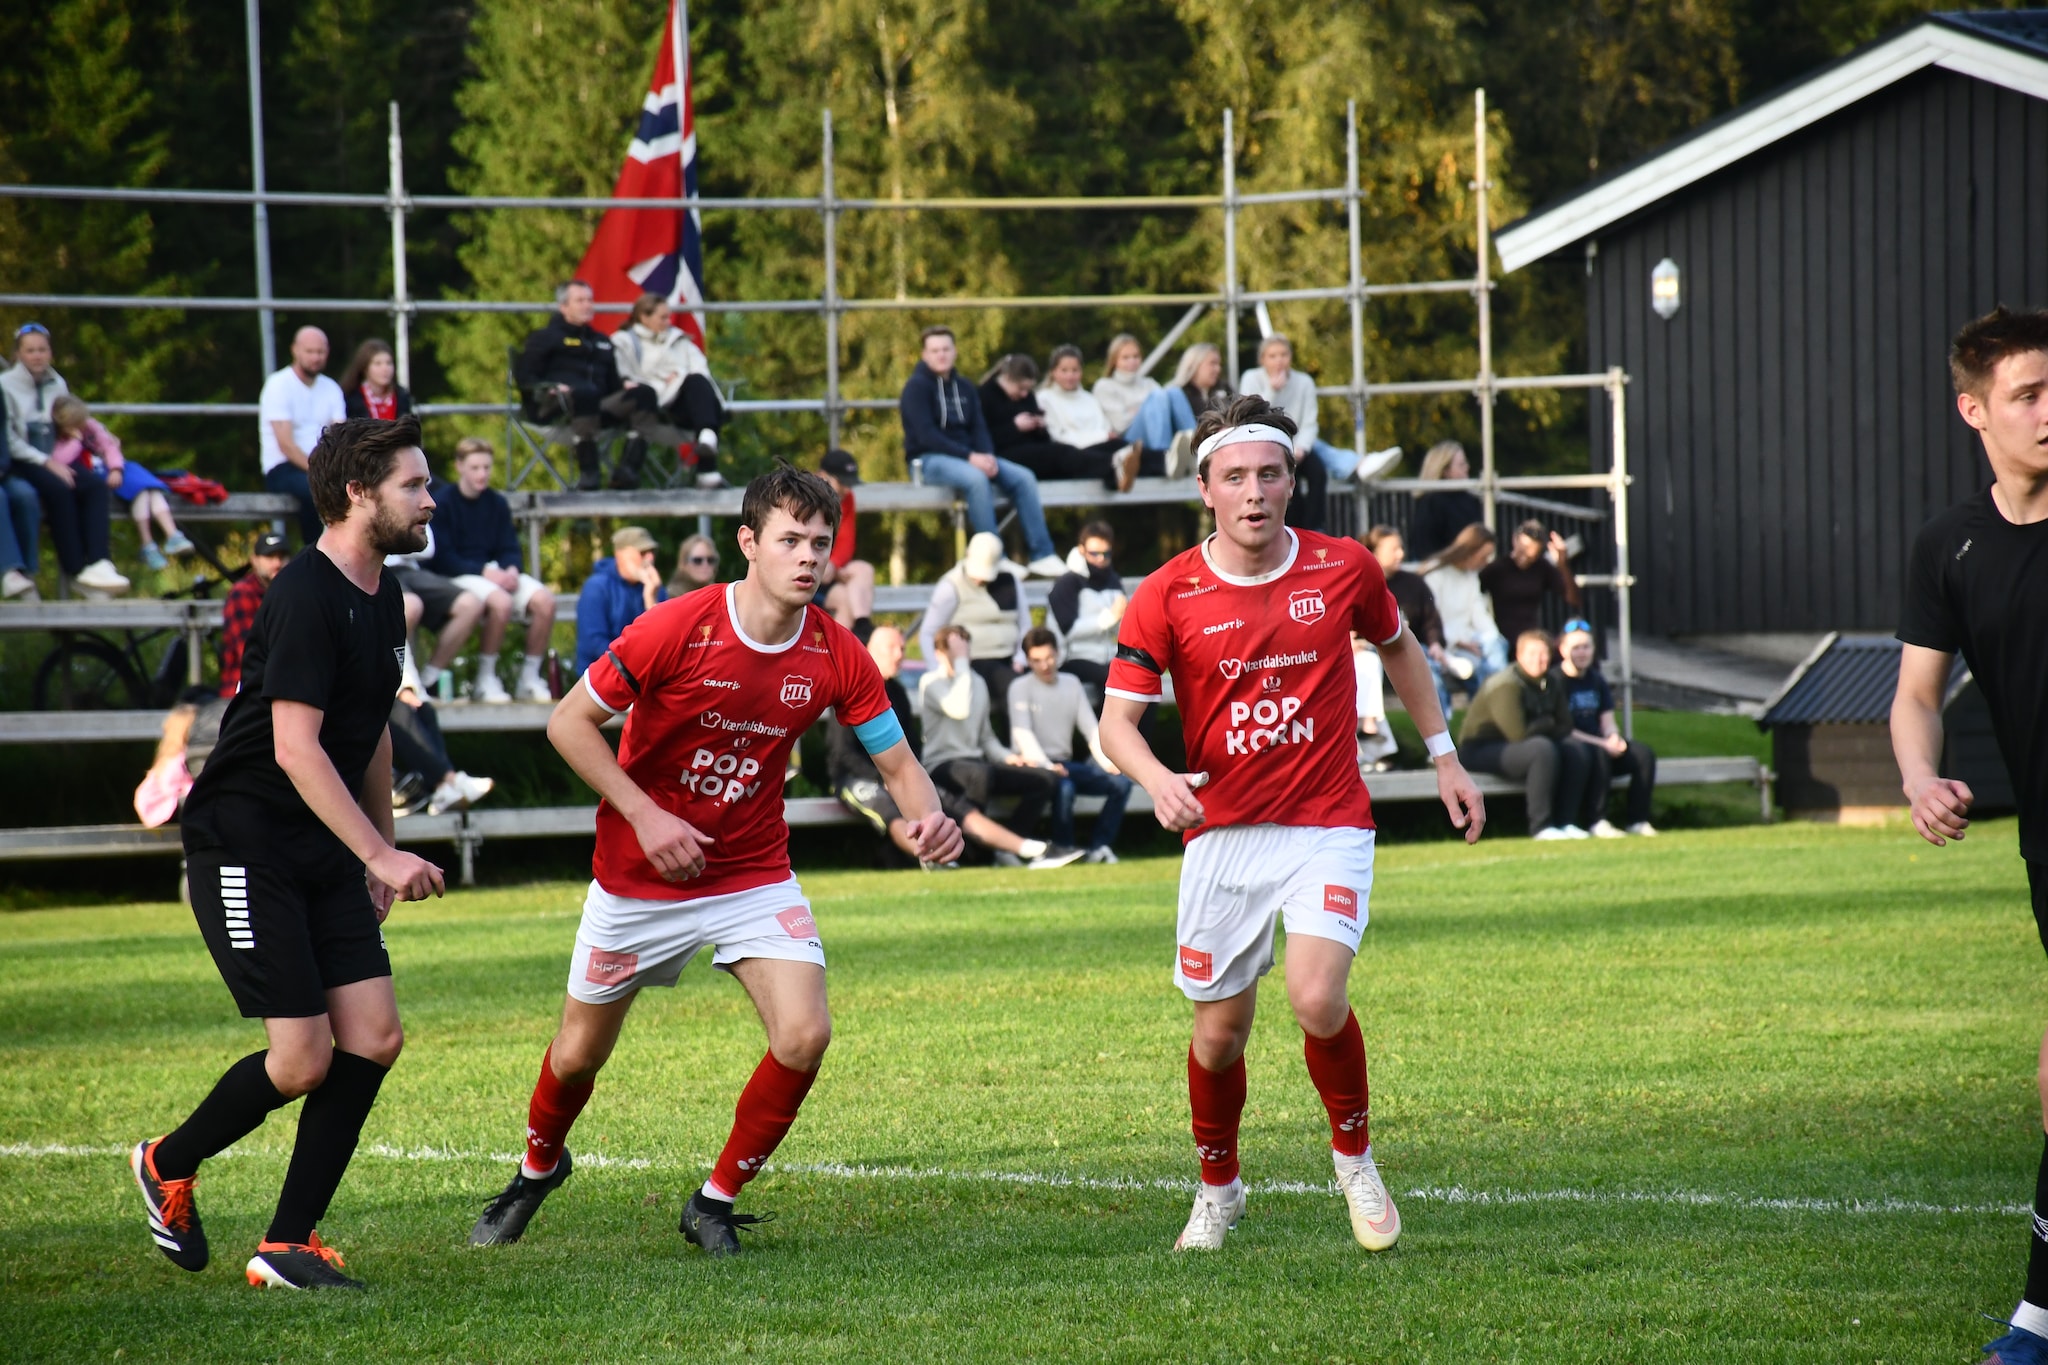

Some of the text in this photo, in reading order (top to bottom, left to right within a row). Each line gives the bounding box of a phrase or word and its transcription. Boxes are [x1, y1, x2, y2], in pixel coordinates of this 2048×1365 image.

[1303, 560, 1346, 571] PREMIESKAPET
[1177, 584, 1219, 600] PREMIESKAPET
[1294, 599, 1323, 617] HIL
[1203, 621, 1236, 635] CRAFT
[1242, 650, 1318, 673] Værdalsbruket
[703, 679, 733, 688] CRAFT
[783, 684, 808, 700] HIL
[1230, 696, 1301, 728] POP
[721, 719, 788, 737] Værdalsbruket
[1225, 717, 1314, 755] KORN
[691, 748, 760, 778] POP
[1328, 893, 1352, 906] HRP
[592, 960, 624, 973] HRP
[1182, 956, 1203, 970] HRP
